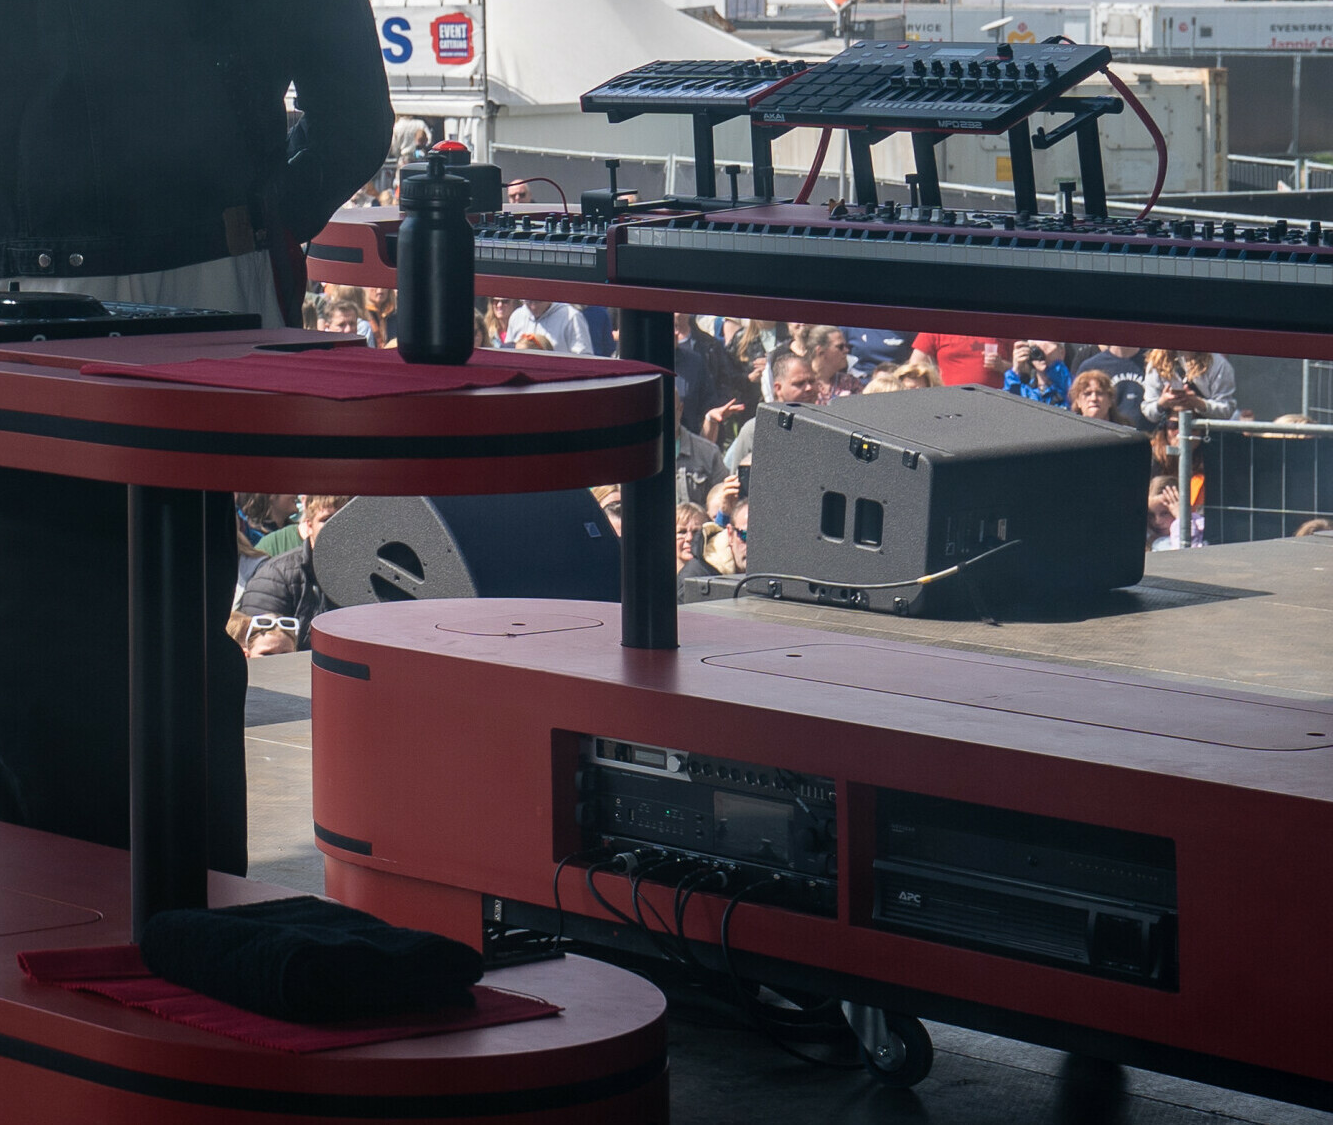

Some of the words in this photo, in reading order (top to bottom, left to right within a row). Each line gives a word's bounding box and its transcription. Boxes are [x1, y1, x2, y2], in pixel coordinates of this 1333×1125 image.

[439, 24, 467, 38] EVENT
[907, 23, 942, 32] RVICE
[1270, 24, 1333, 32] EVENEMEN
[899, 891, 922, 903] APC
